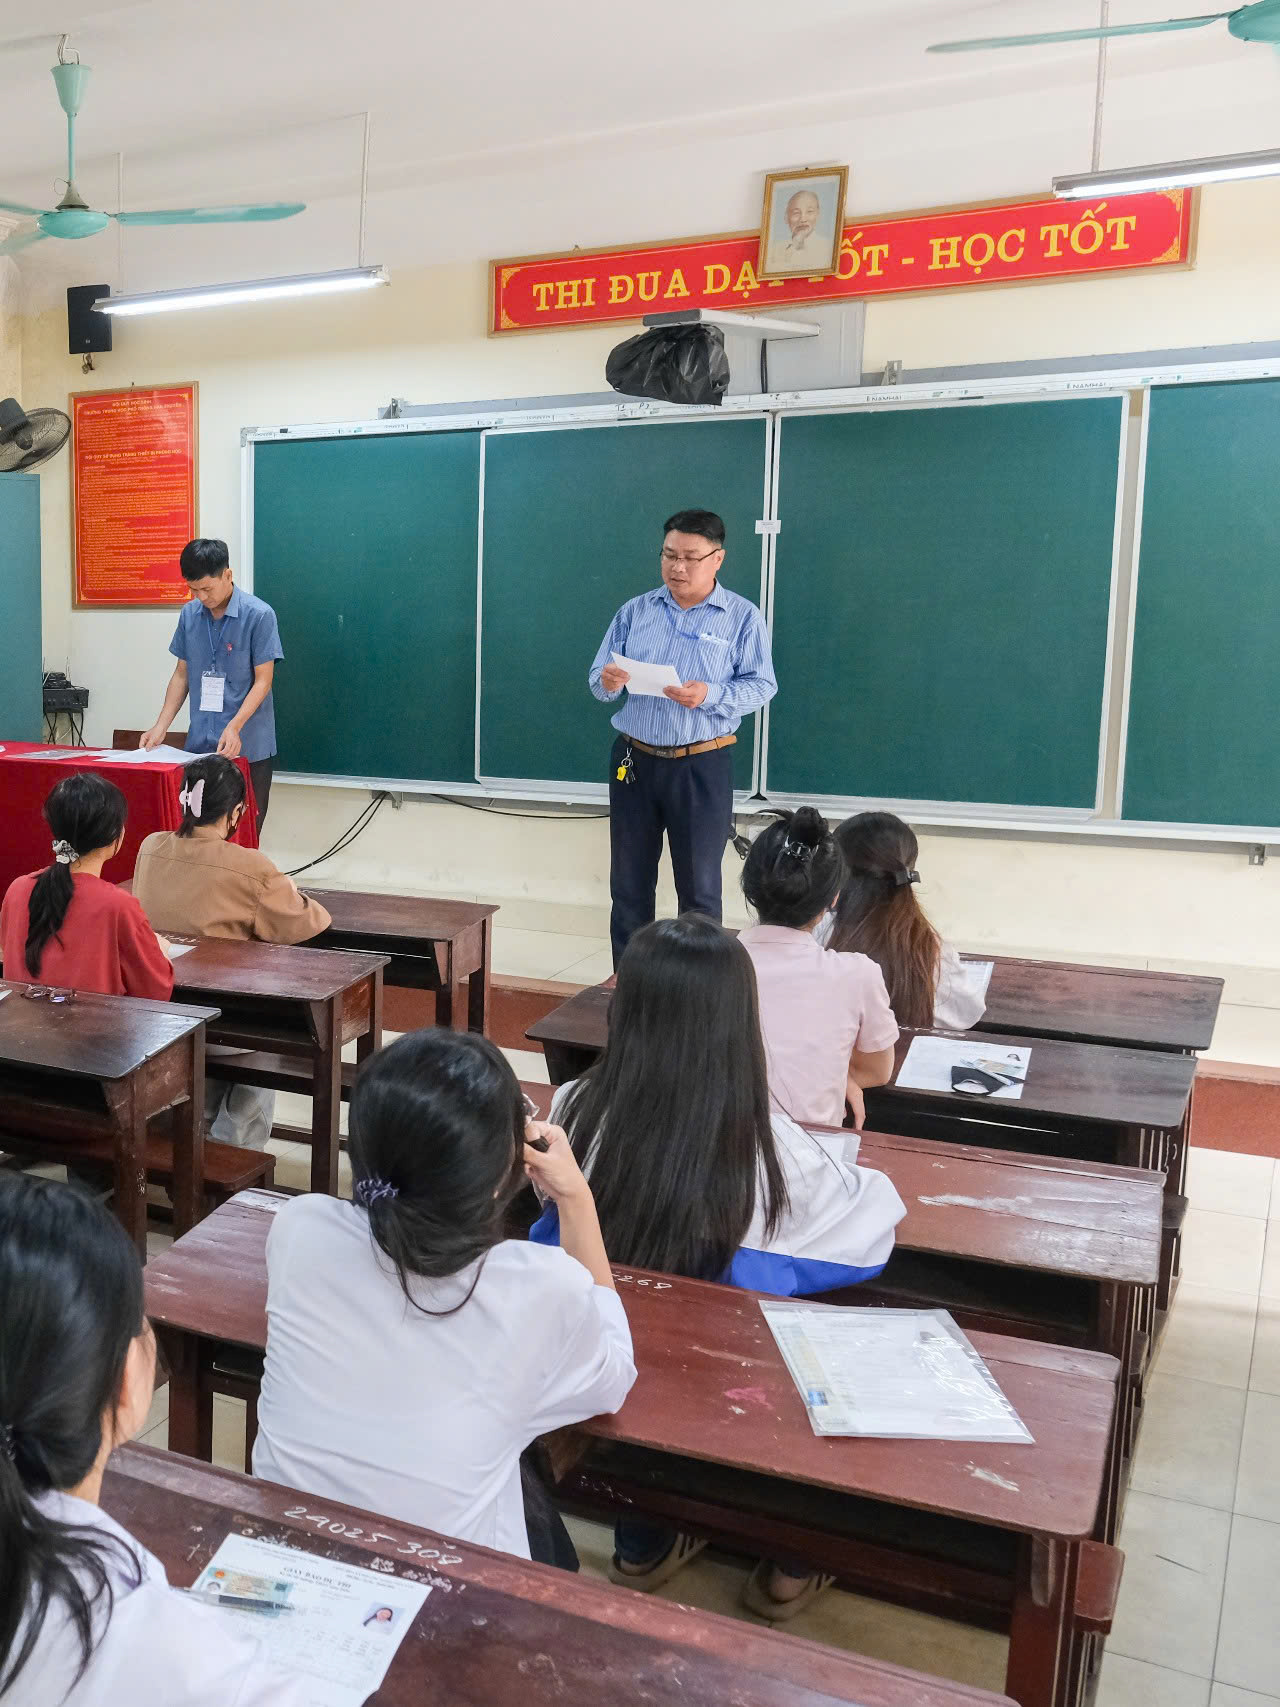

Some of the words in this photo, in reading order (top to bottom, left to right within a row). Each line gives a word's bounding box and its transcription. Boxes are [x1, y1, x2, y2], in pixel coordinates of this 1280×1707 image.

[532, 278, 596, 311] THI
[608, 268, 690, 304] ĐUA
[703, 260, 784, 298] DẠ
[808, 231, 889, 283] ỐT
[928, 228, 1025, 274] HỌC
[1040, 201, 1136, 258] TỐT
